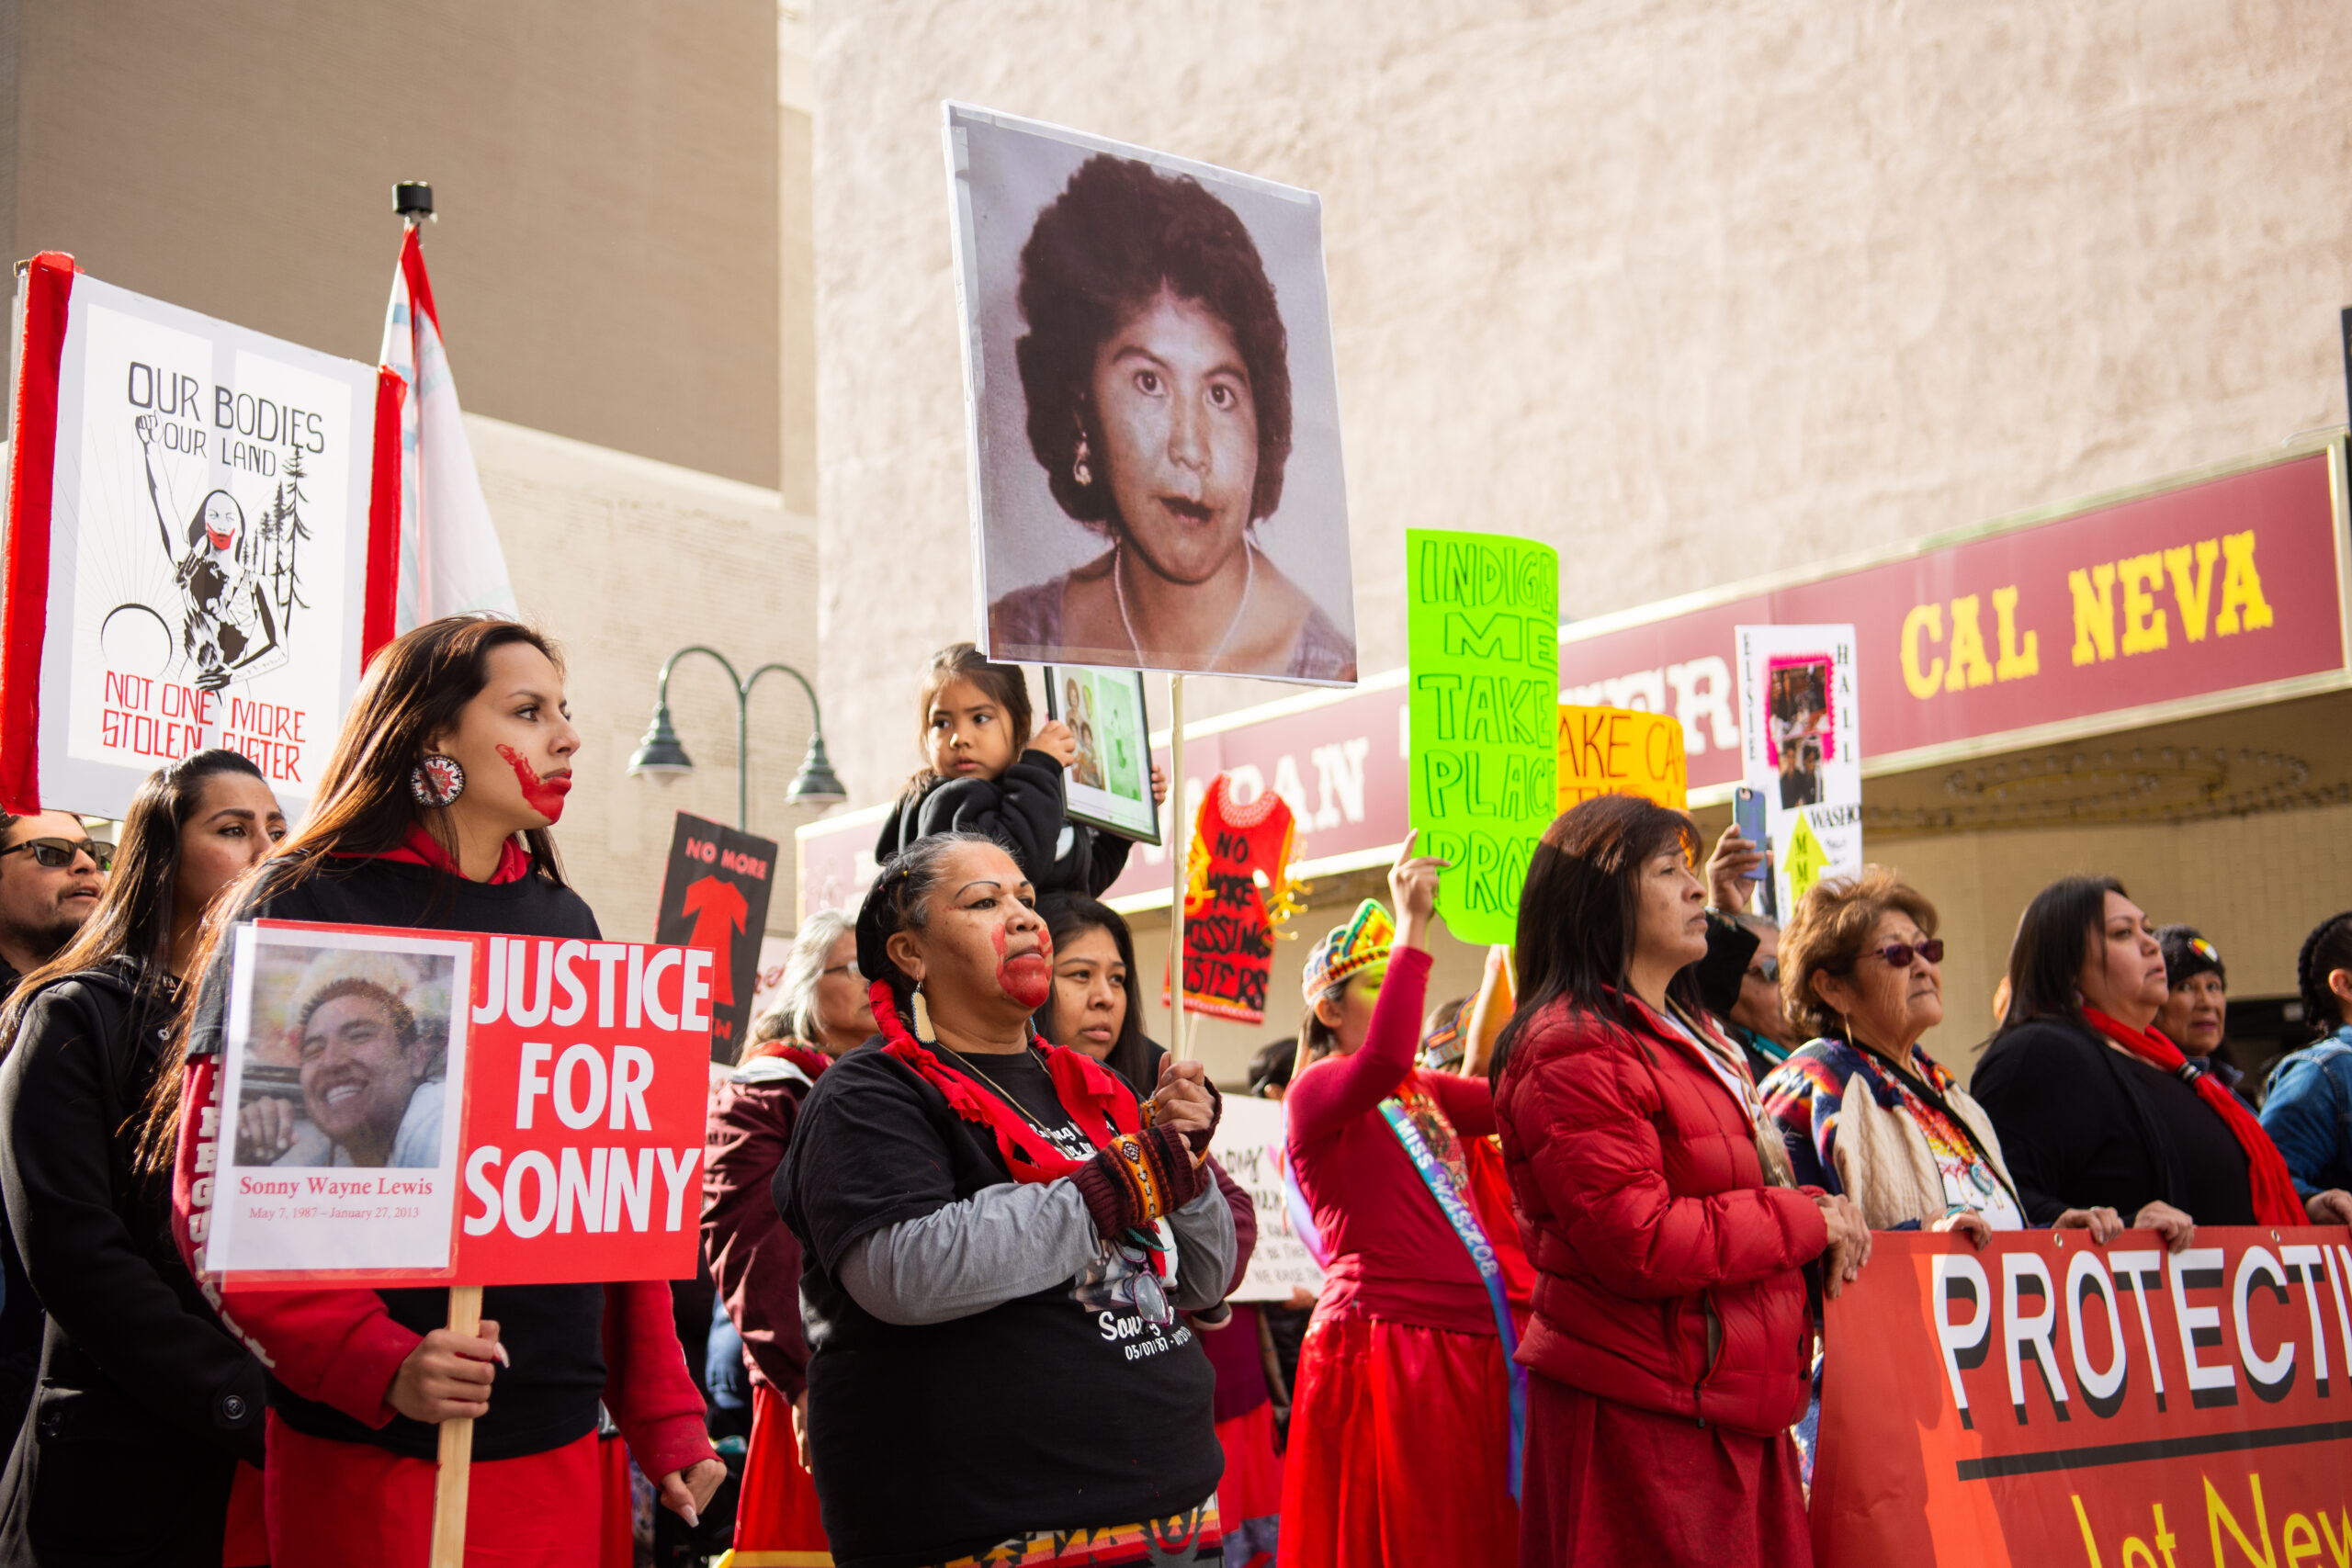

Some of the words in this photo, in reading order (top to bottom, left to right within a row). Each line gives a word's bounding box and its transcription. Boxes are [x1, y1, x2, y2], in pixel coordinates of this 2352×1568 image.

[129, 361, 201, 423] OUR
[214, 384, 325, 455] BODIES
[164, 422, 208, 460] OUR
[221, 436, 277, 478] LAND
[1900, 584, 2039, 700] CAL
[2067, 529, 2274, 667] NEVA
[106, 670, 154, 712] NOT
[162, 683, 215, 726] ONE
[231, 696, 306, 743] MORE
[1418, 672, 1553, 750] TAKE
[1743, 632, 1756, 761] ELSIE
[1837, 642, 1852, 764] HALL
[103, 708, 202, 761] STOLEN
[684, 838, 718, 863] NO
[720, 848, 768, 881] MORE
[1215, 830, 1250, 864] NO
[472, 936, 713, 1032] JUSTICE
[1183, 955, 1270, 1011] ISTERS
[515, 1042, 652, 1131] FOR
[1395, 1117, 1434, 1169] MISS
[239, 1176, 300, 1199] Sonny
[306, 1176, 372, 1199] Wayne
[378, 1177, 433, 1195] Lewis
[249, 1207, 275, 1219] May
[279, 1207, 288, 1220] 7,
[292, 1207, 318, 1219] 1987
[328, 1207, 371, 1220] January
[375, 1207, 390, 1220] 27,
[394, 1207, 419, 1218] 2013
[464, 1145, 702, 1239] SONNY
[1125, 1337, 1170, 1360] 05/07/87
[1932, 1244, 2352, 1422] PROTECTI
